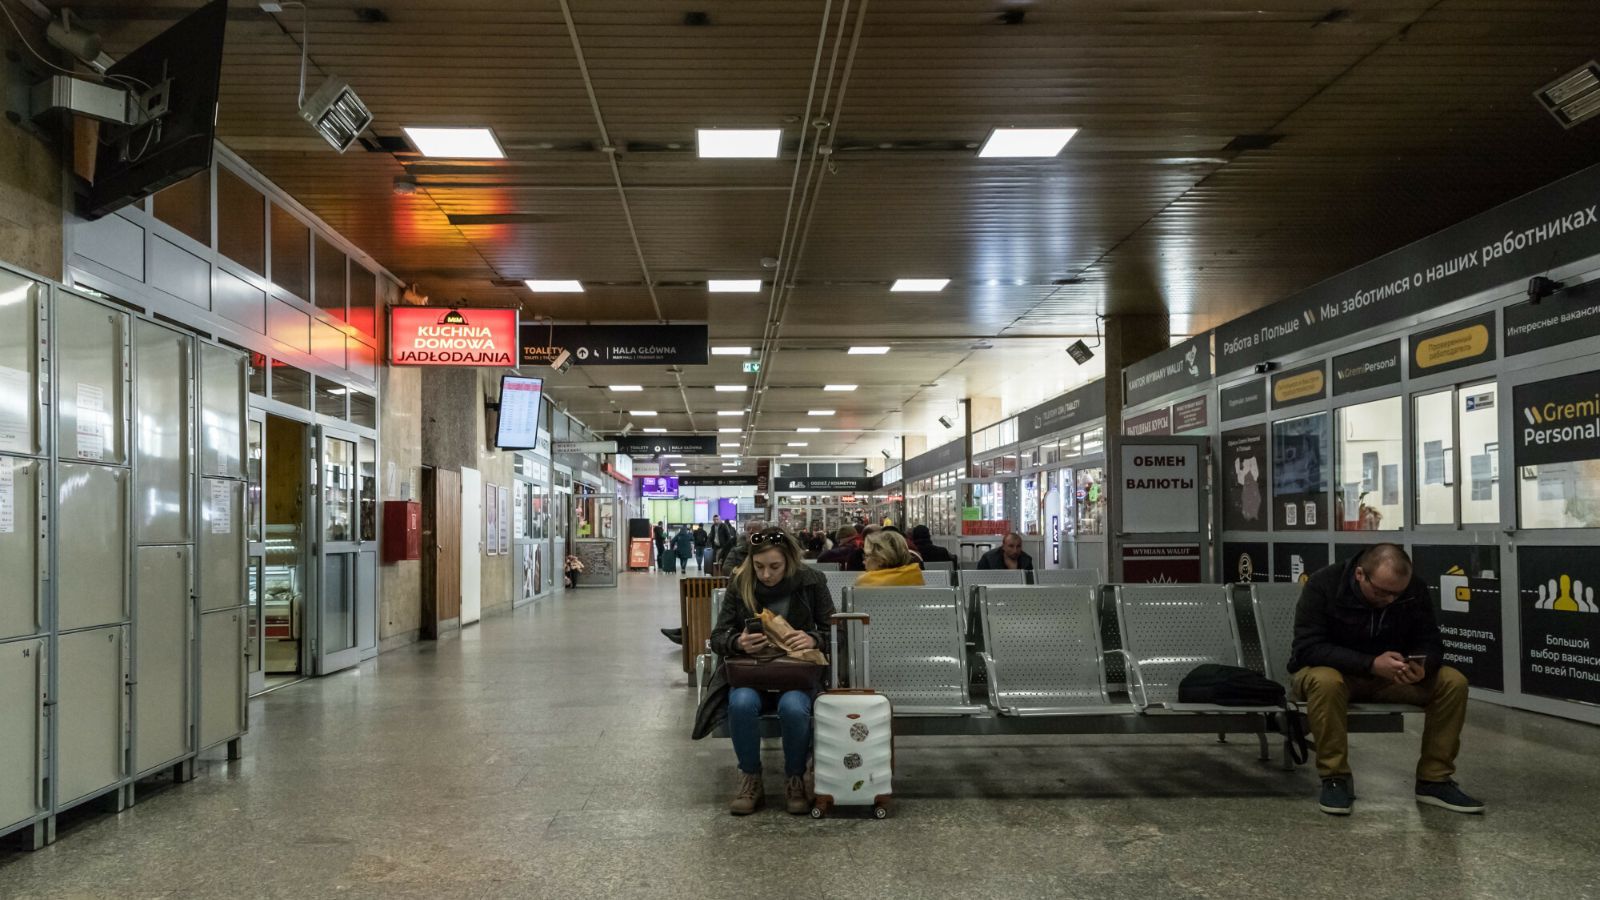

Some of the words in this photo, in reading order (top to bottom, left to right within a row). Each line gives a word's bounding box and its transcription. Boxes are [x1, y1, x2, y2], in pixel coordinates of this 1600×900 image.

[1224, 335, 1252, 356] Работа
[1253, 334, 1260, 346] в
[1261, 318, 1300, 344] Польше
[1320, 302, 1339, 331] Мы
[1342, 276, 1410, 322] заботимся
[1413, 273, 1423, 287] о
[1426, 249, 1478, 293] наших
[1482, 204, 1598, 267] работниках
[418, 326, 492, 337] KUCHNIA
[1507, 315, 1559, 337] Интересные
[414, 338, 495, 349] DOMOWA
[524, 346, 563, 354] TOALETY
[612, 346, 637, 354] HALA
[638, 345, 677, 354] GŁÓWNA
[397, 351, 511, 363] JADŁODAJNIA
[1543, 393, 1600, 422] Gremi
[1524, 417, 1600, 446] Personal
[1133, 456, 1186, 467] ОБМЕН
[1126, 478, 1194, 489] ВАЛЮТЫ
[1459, 627, 1496, 641] зарплата,
[1546, 634, 1590, 649] Большой
[1530, 648, 1560, 662] выбор
[1531, 664, 1543, 673] по
[1544, 666, 1567, 677] всей
